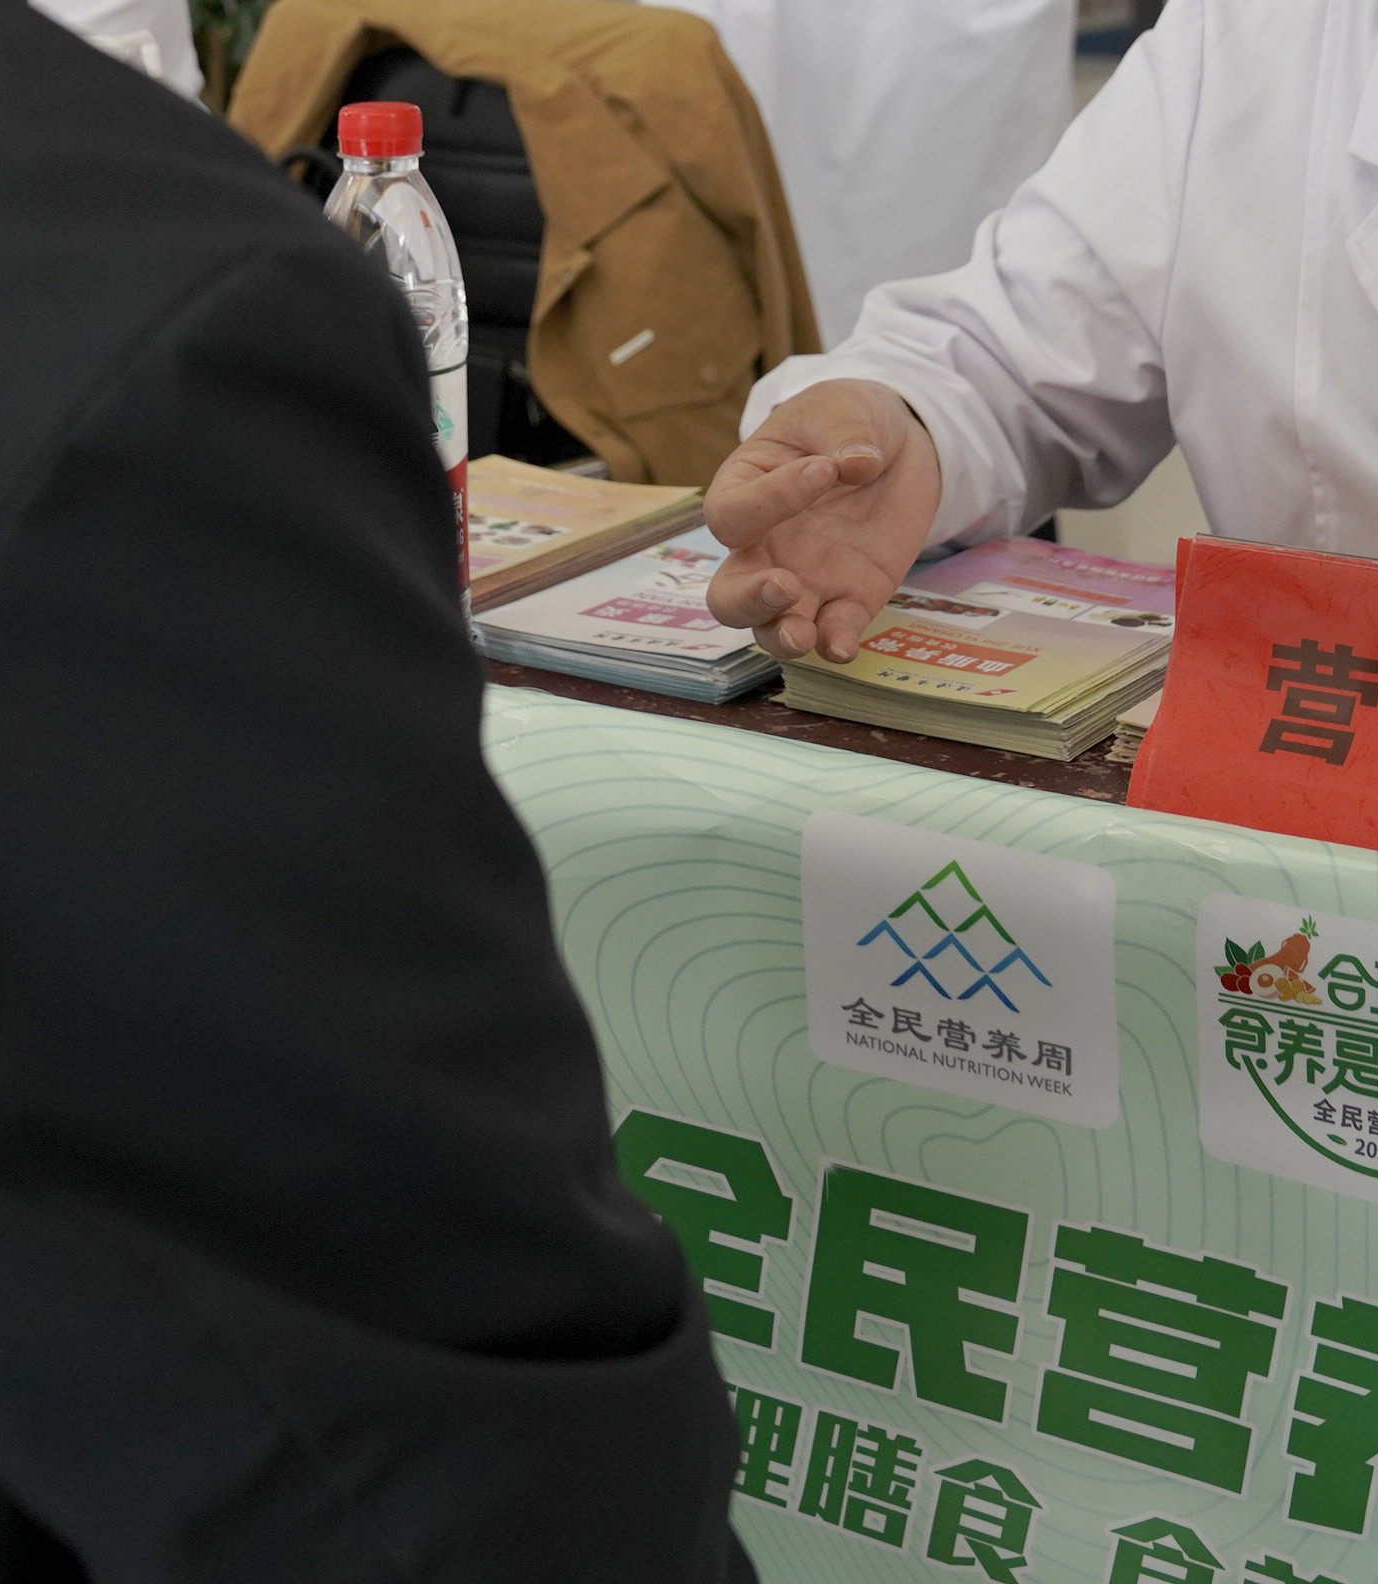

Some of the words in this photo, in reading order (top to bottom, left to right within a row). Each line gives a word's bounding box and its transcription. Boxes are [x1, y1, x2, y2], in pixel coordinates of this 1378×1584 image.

[868, 638, 1014, 673] 血脂异常
[841, 996, 1072, 1076] 全民营养周
[846, 1031, 927, 1063] NATIONAL
[933, 1052, 1023, 1085] NUTRITION
[1027, 1074, 1073, 1097] WEEK
